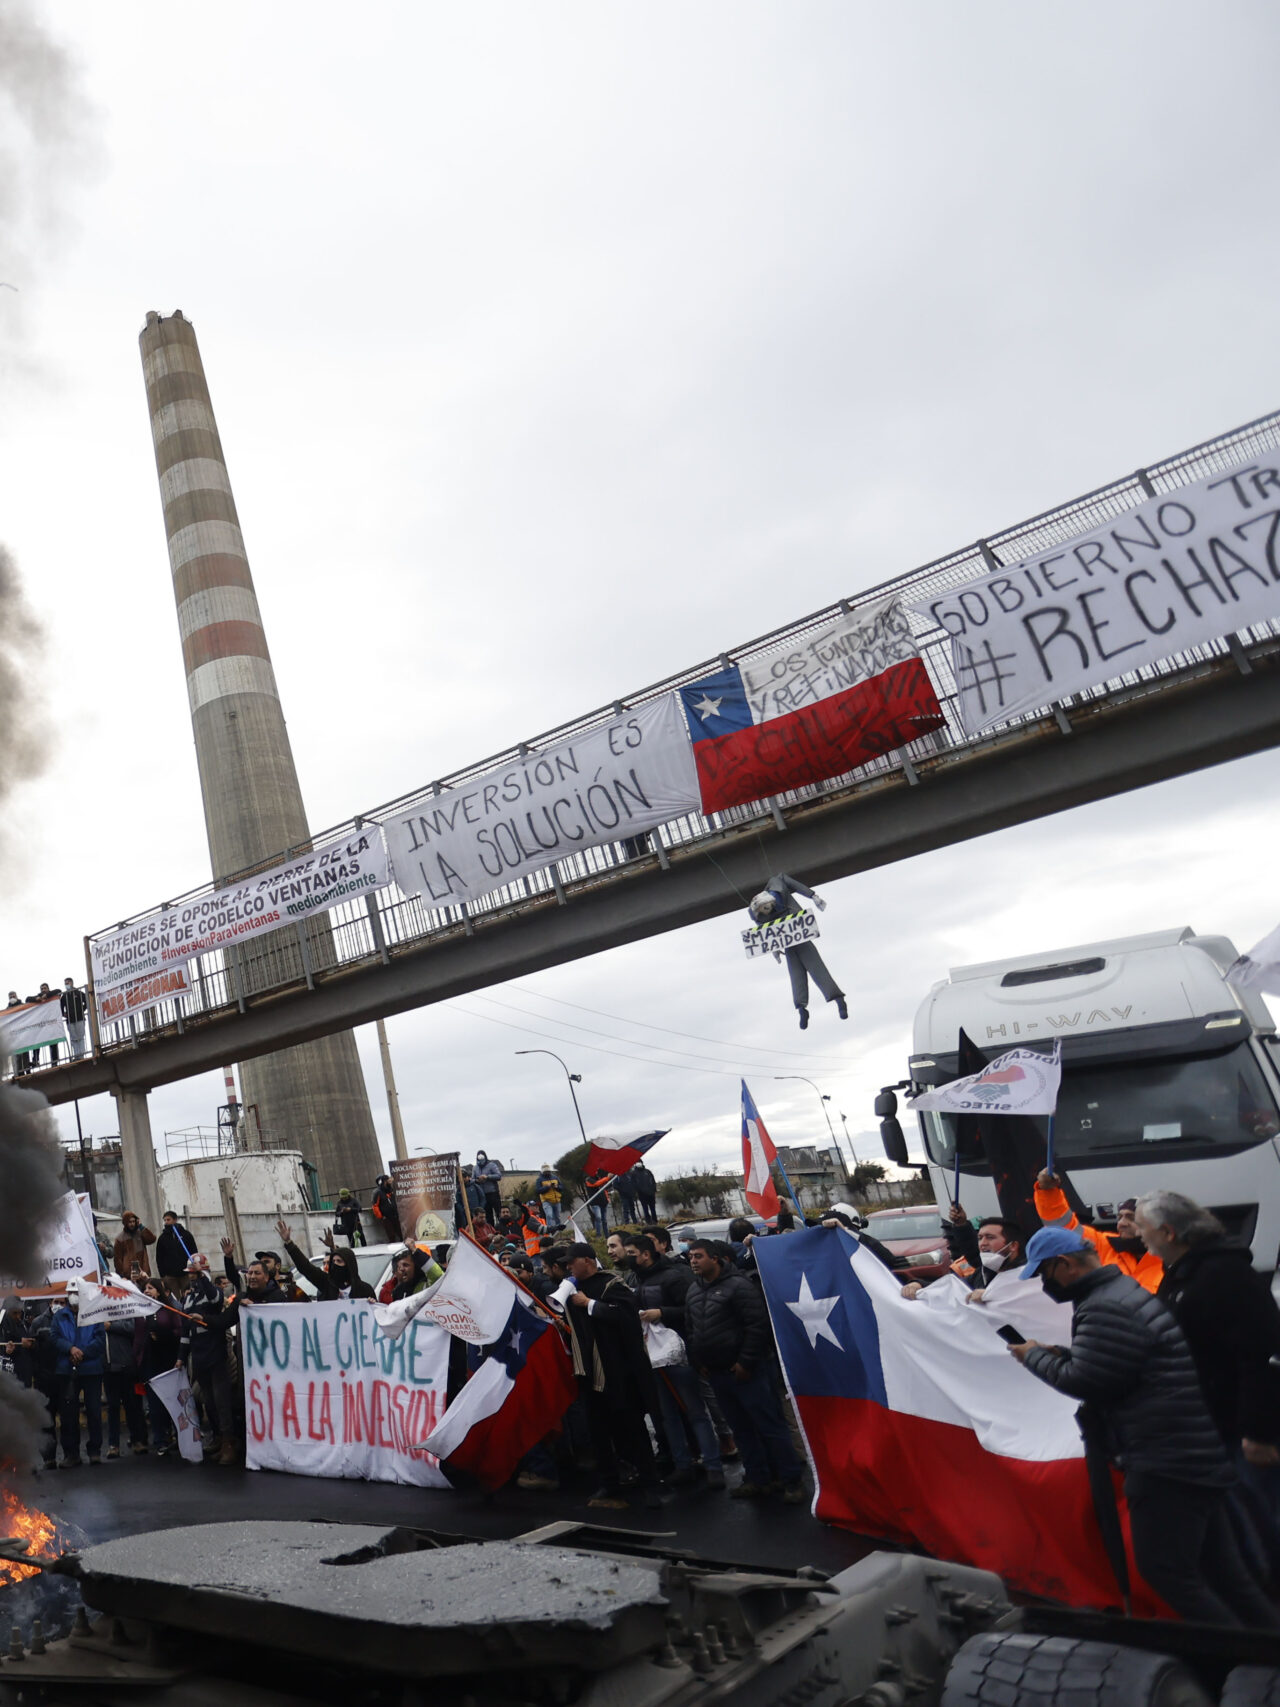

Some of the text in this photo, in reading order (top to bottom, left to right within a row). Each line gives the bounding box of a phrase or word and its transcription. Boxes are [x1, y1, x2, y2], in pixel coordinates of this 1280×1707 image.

[930, 501, 1196, 636] GOBIERNO
[608, 719, 642, 756] ES
[420, 766, 652, 900] LA SOLUCIÓN
[95, 836, 370, 959] MAITENES SE OPONE AL CIERRE DE LA
[175, 924, 193, 943] DE
[198, 896, 265, 935] CODELCO
[268, 859, 361, 906] VENTANAS
[287, 873, 377, 916] medioambiente
[986, 1004, 1133, 1038] HI-WAY
[246, 1299, 434, 1385] NO AL CIERRE
[282, 1380, 302, 1441] A
[307, 1380, 336, 1446] LA
